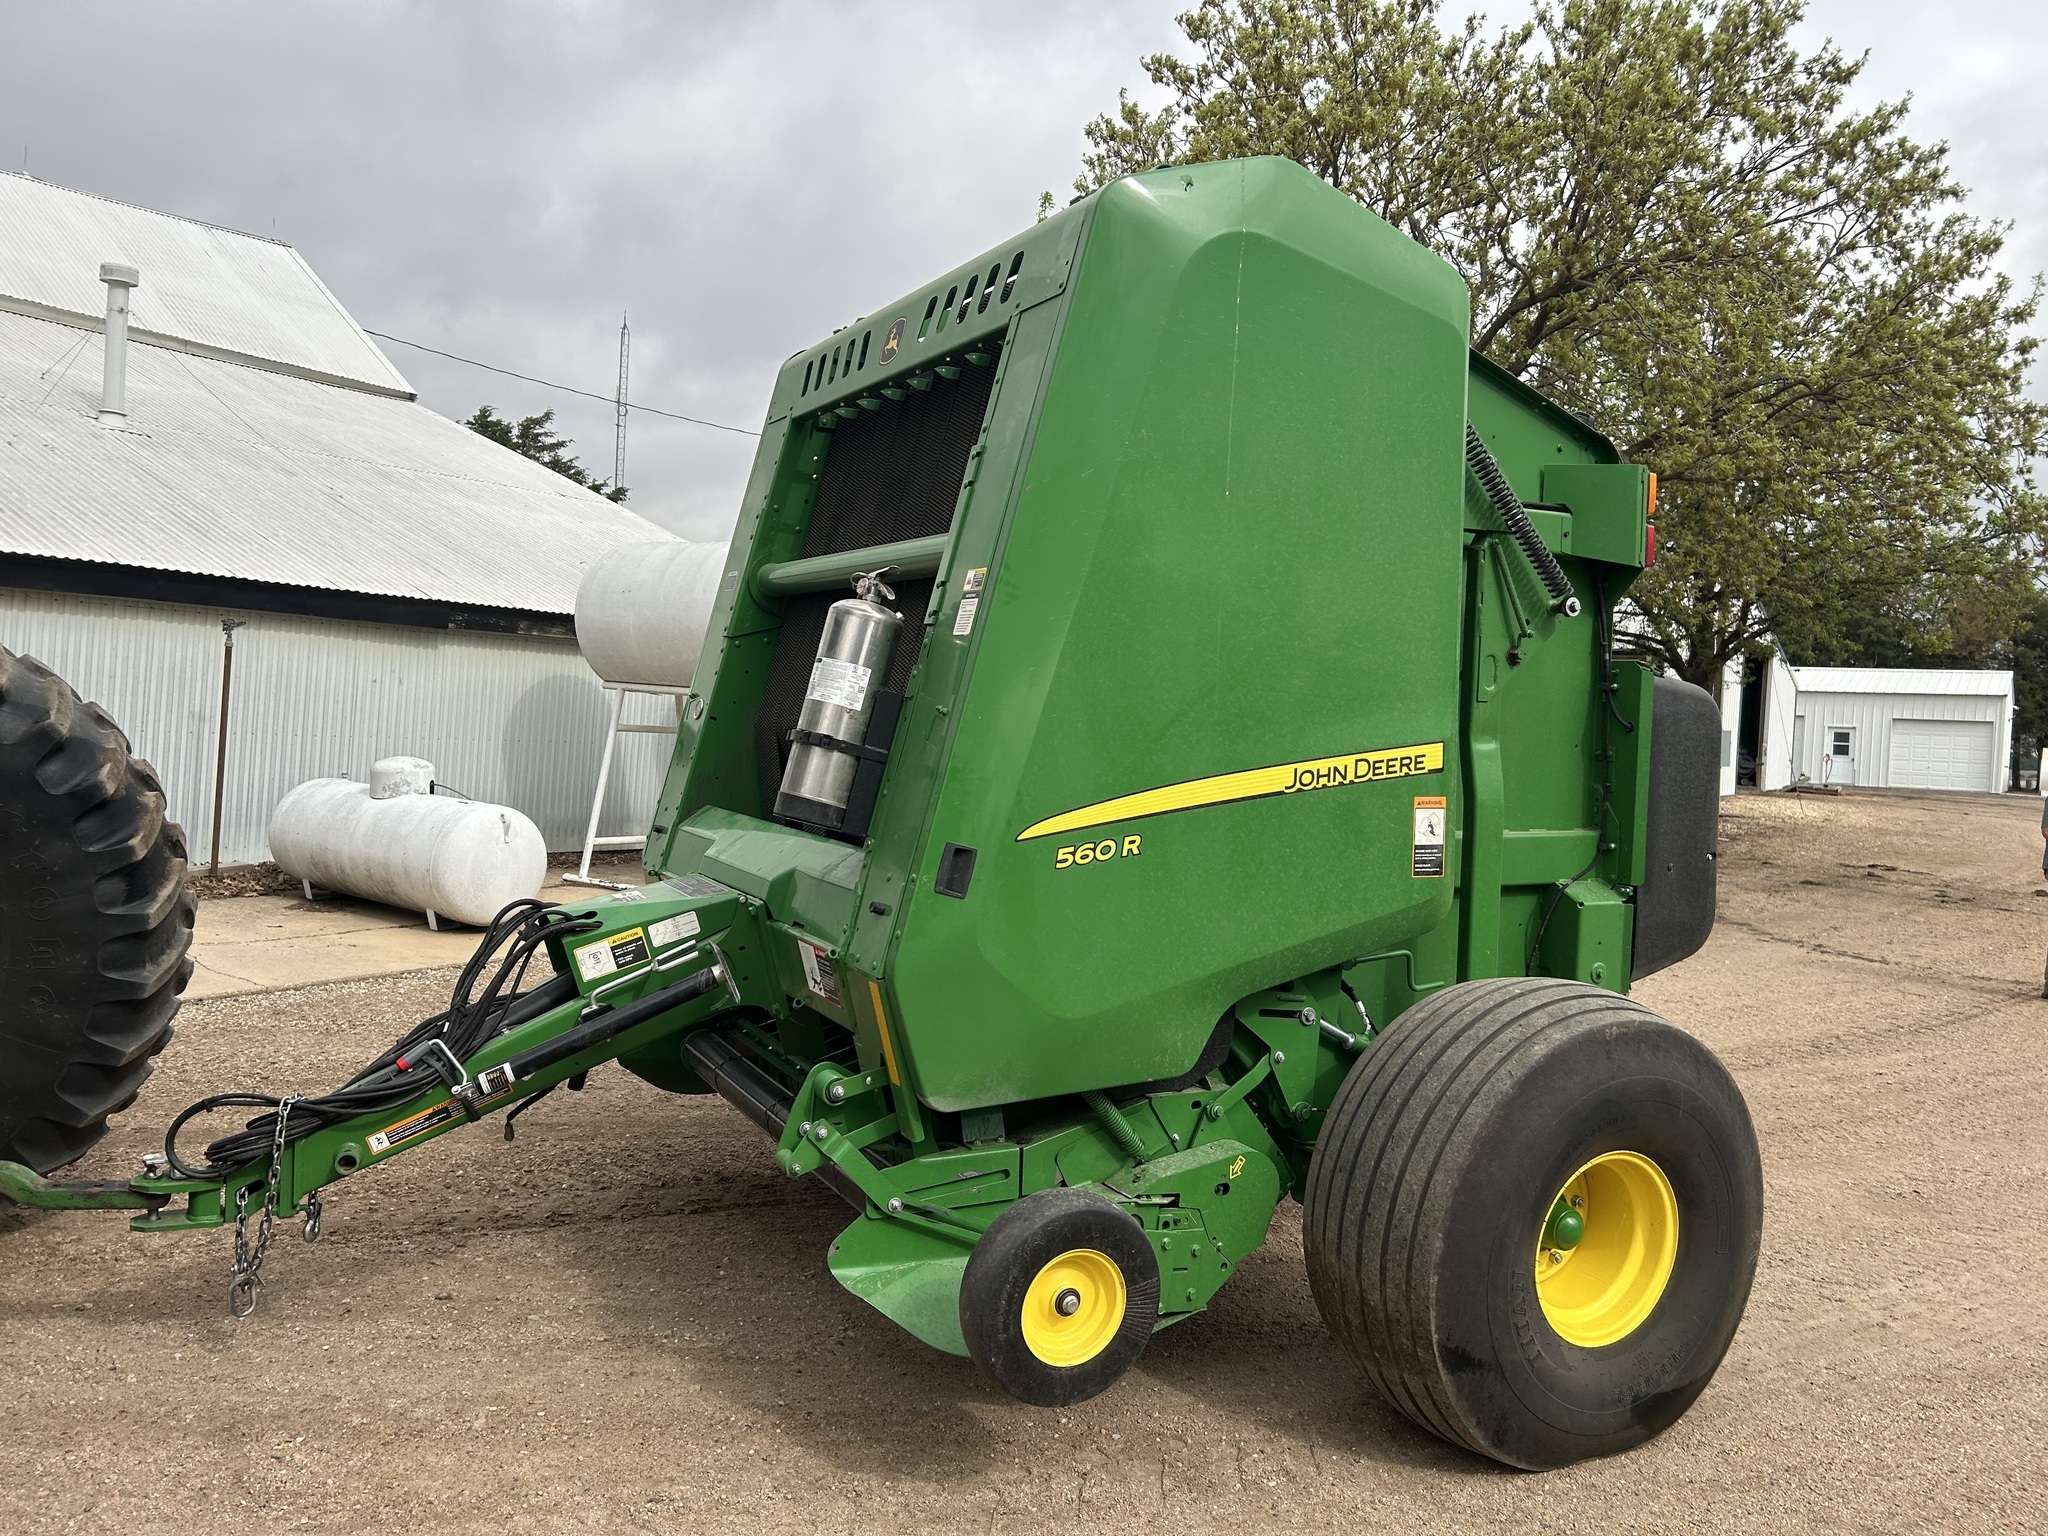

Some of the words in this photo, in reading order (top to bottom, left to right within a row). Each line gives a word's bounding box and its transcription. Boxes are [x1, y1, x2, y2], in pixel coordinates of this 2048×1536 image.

[1284, 767, 1348, 790] JOHN
[1353, 754, 1427, 780] DEERE
[1055, 841, 1117, 869] 560
[1121, 833, 1142, 858] R
[616, 931, 639, 943] CAUTION
[1512, 1270, 1545, 1371] TITAN
